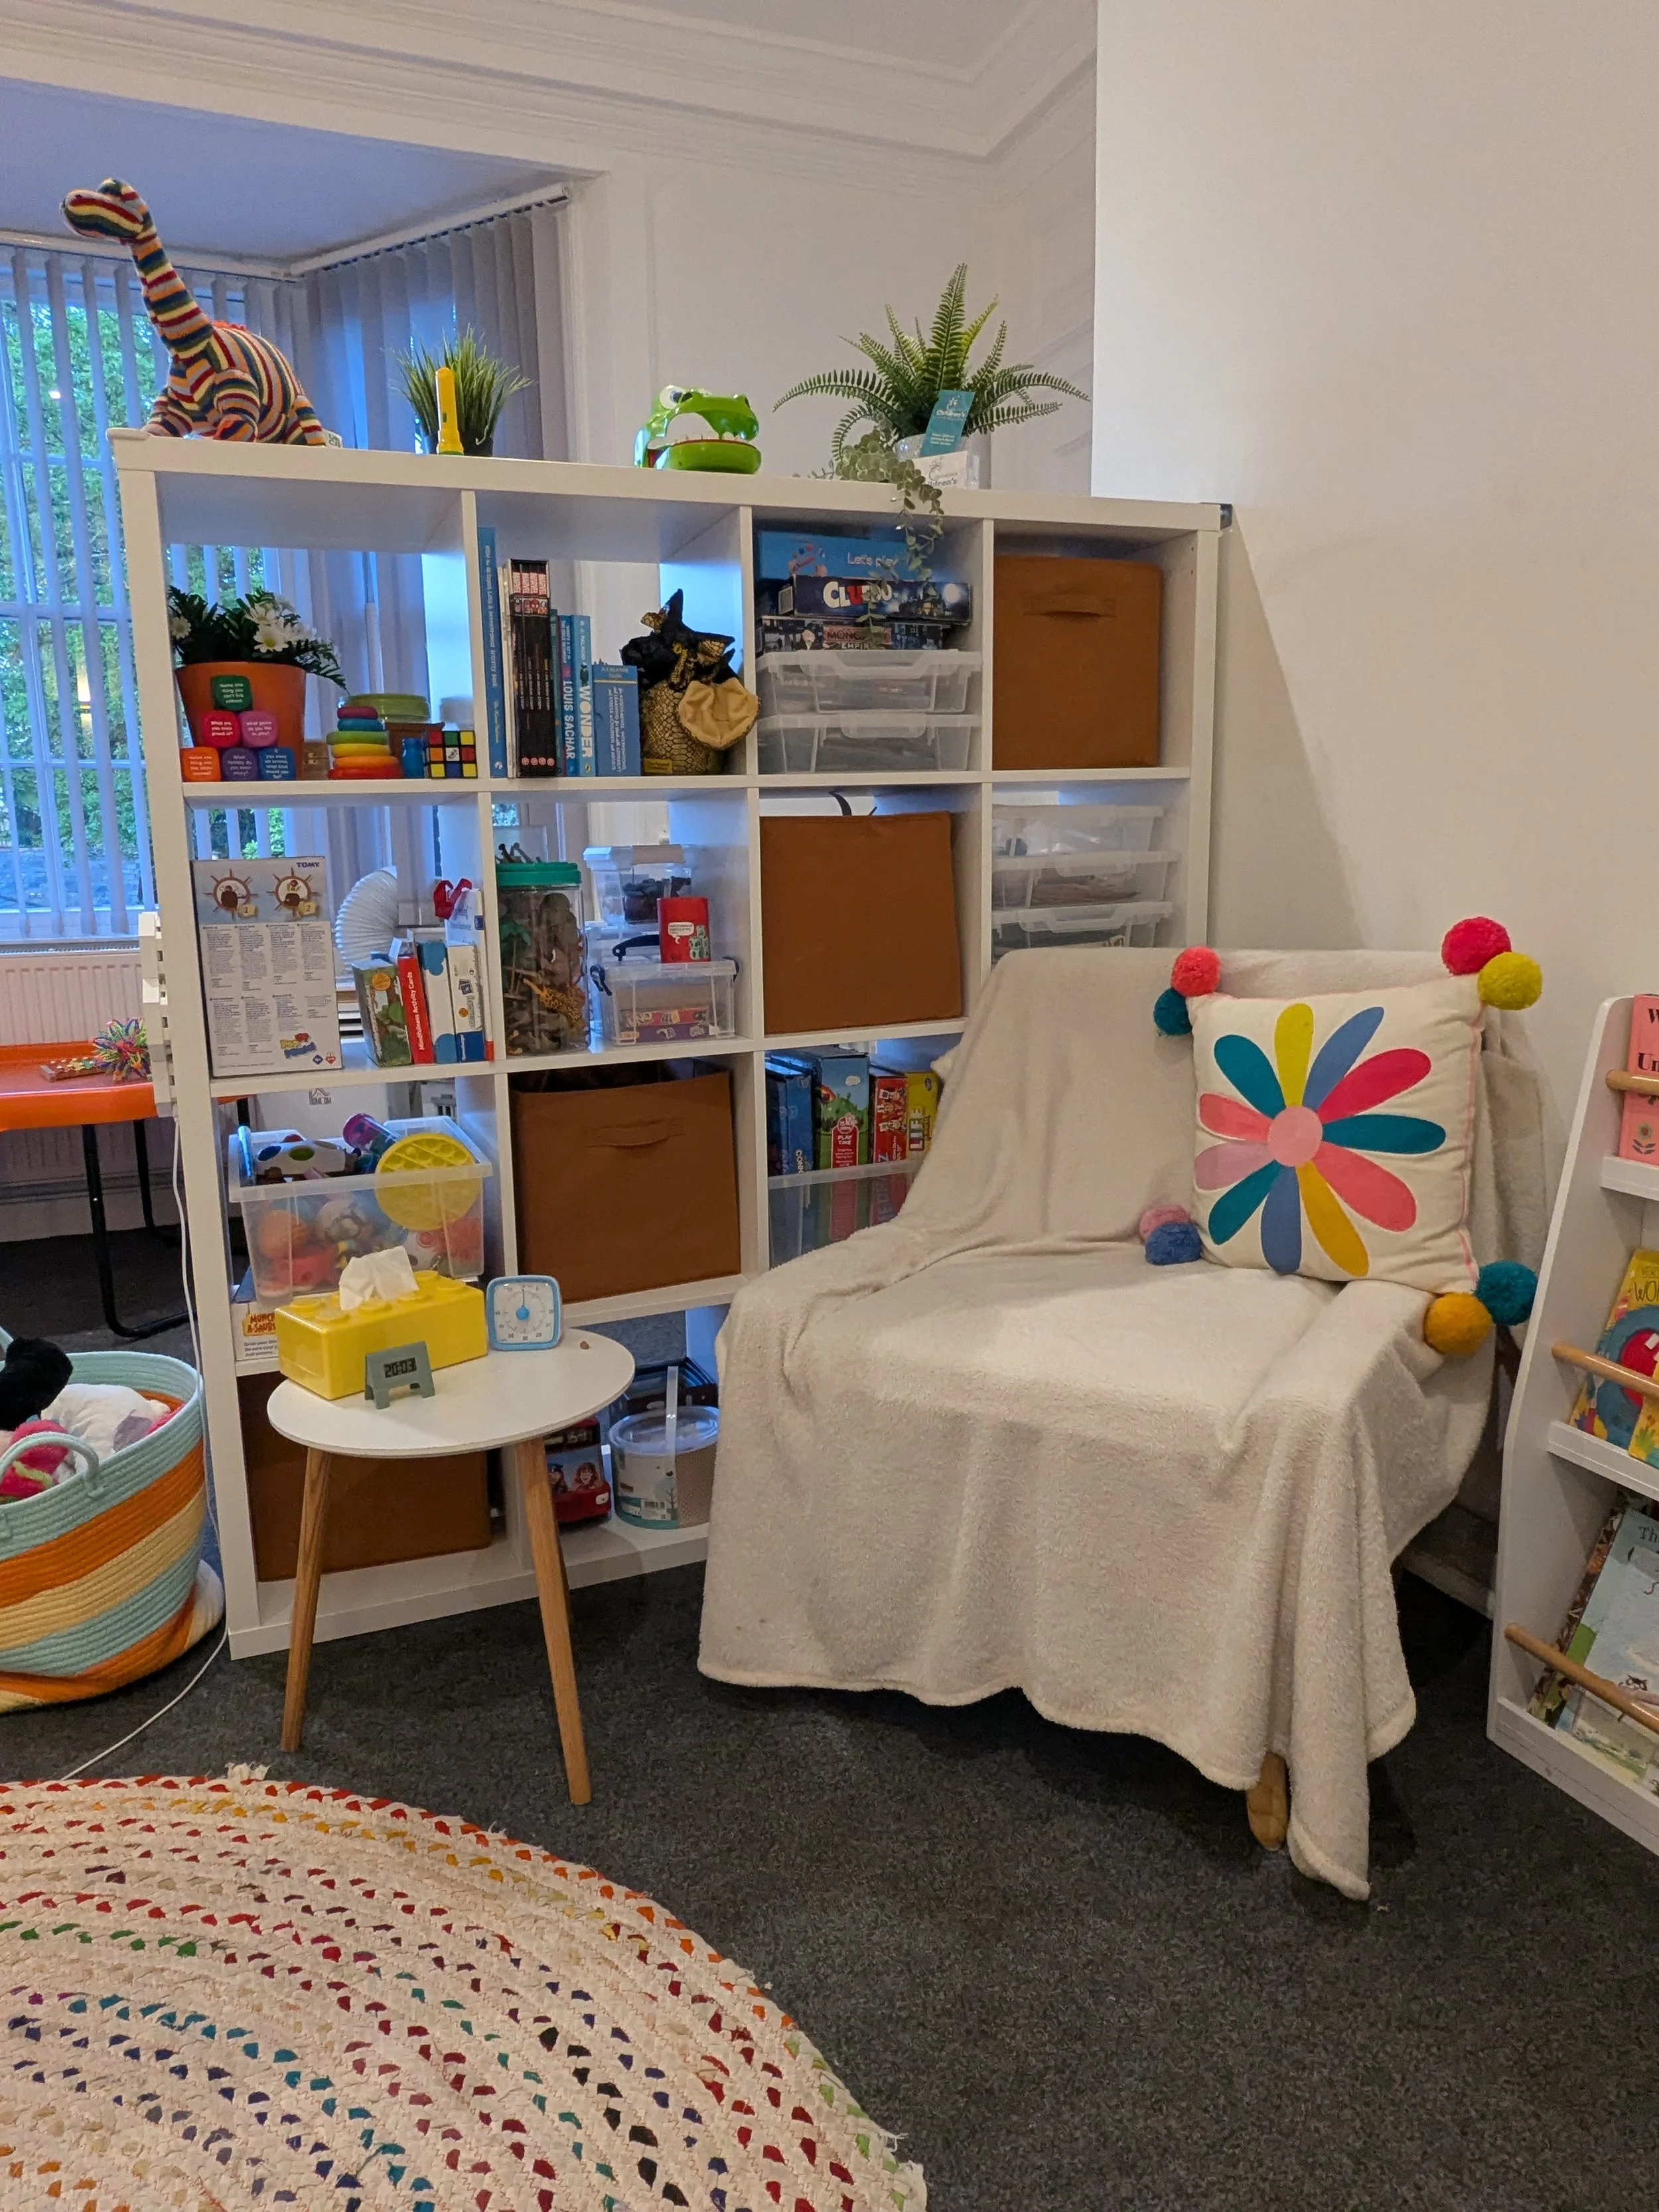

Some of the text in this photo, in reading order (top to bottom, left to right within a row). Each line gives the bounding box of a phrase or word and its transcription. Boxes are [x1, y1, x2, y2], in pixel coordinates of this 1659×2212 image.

[563, 681, 576, 759] LOUIS SACHAR
[579, 685, 593, 758] WONDER
[406, 972, 425, 1051] Mindfulness Activity Cards
[1639, 1526, 1659, 1544] Th
